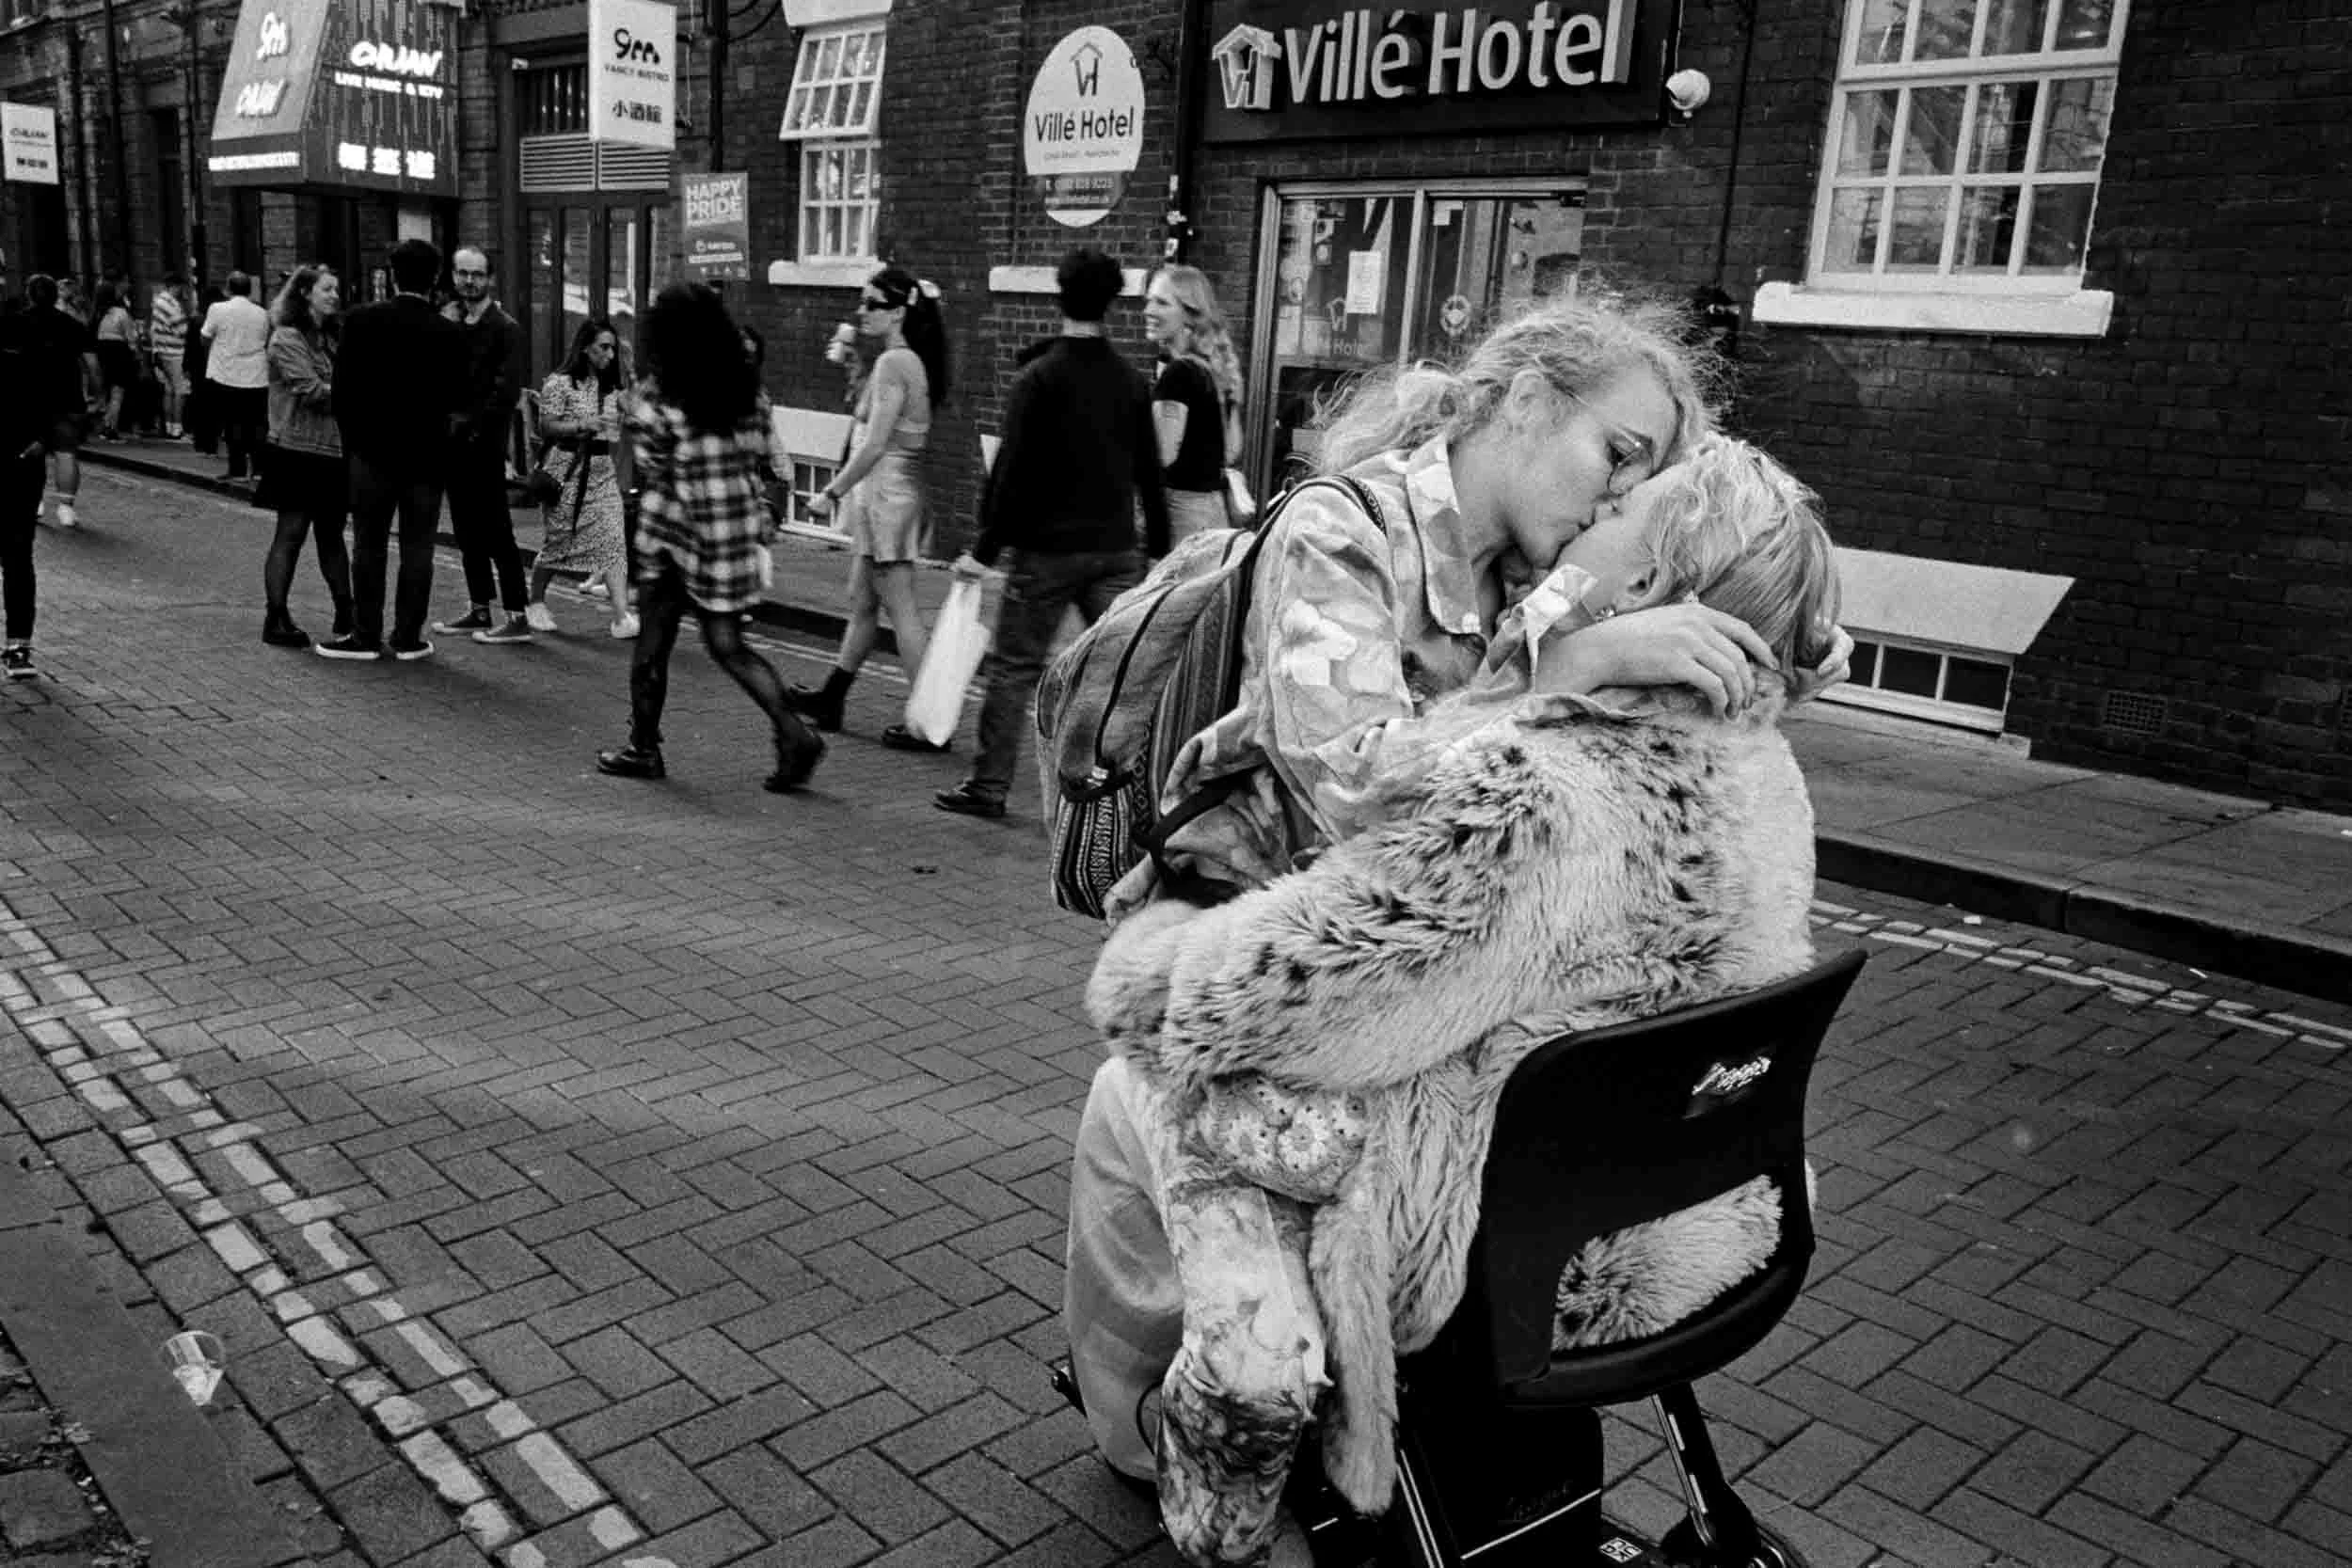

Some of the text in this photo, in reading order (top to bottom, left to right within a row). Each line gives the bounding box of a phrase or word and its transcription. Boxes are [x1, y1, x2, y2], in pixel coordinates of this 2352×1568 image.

[1284, 0, 1626, 104] Villé Hotel
[1035, 105, 1135, 142] Villé Hotel
[686, 177, 742, 199] HAPPY
[686, 195, 743, 220] PRIDE
